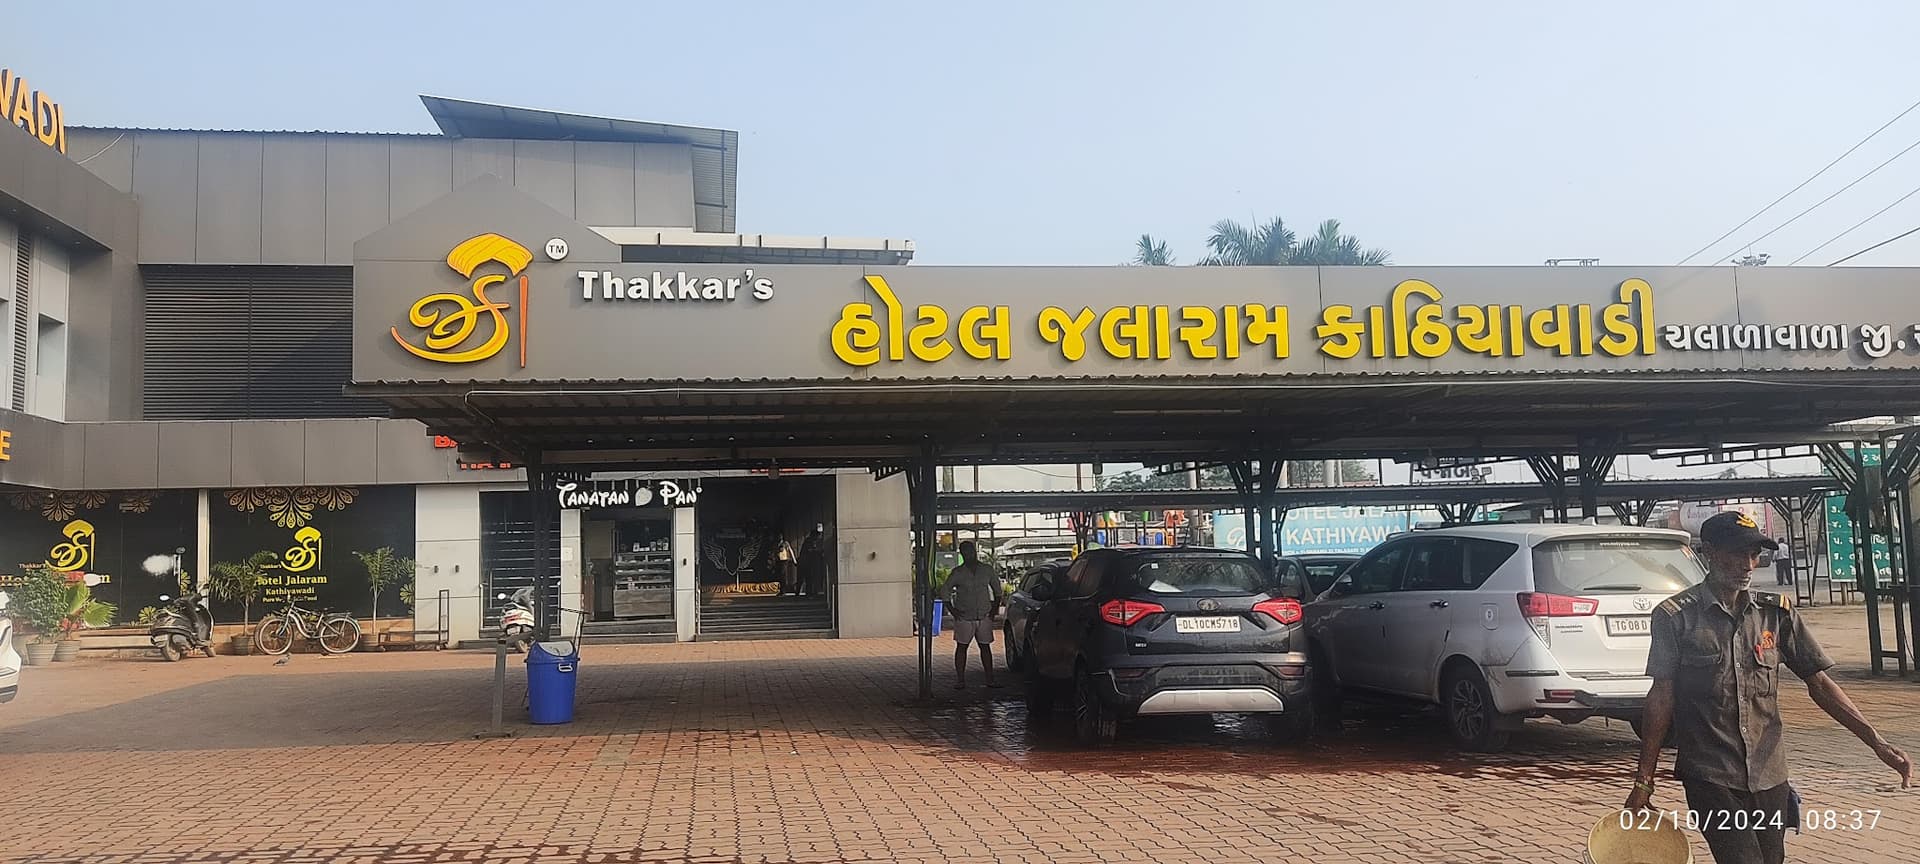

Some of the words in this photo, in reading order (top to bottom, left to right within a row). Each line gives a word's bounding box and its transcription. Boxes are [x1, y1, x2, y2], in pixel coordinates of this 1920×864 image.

[578, 269, 774, 300] Thakkar's
[830, 274, 1012, 366] હોટલ
[1037, 303, 1290, 362] જલારામ
[1315, 277, 1656, 359] કાઠિયાવાડી
[285, 575, 328, 586] Jalaram
